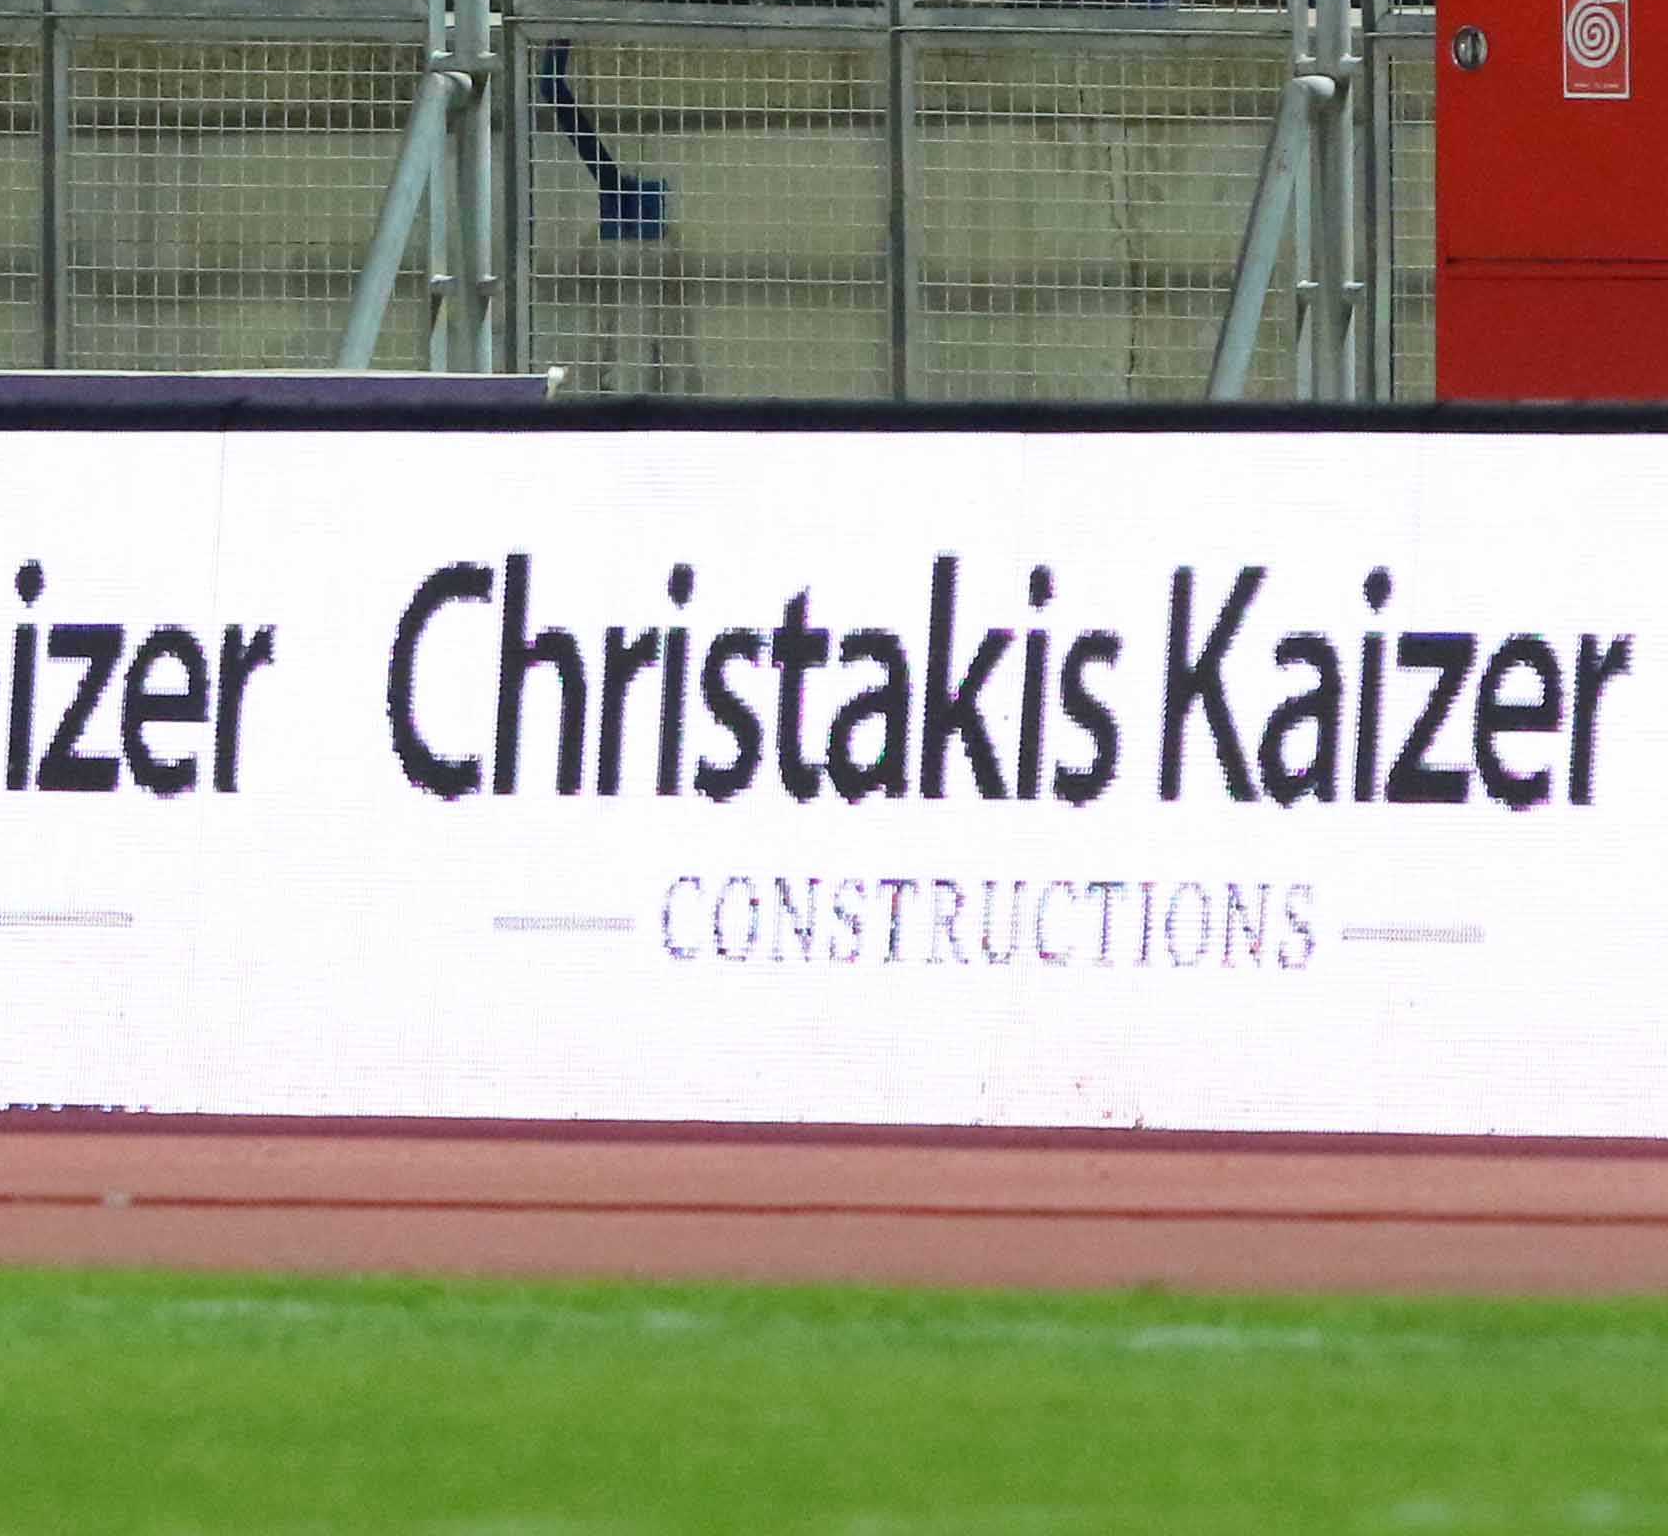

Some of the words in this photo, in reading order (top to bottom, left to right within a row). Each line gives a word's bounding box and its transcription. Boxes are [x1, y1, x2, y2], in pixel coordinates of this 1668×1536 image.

[387, 552, 1121, 806] Christakis
[1159, 567, 1634, 811] Kaizer
[661, 875, 1317, 969] CONSTRUCTIONS
